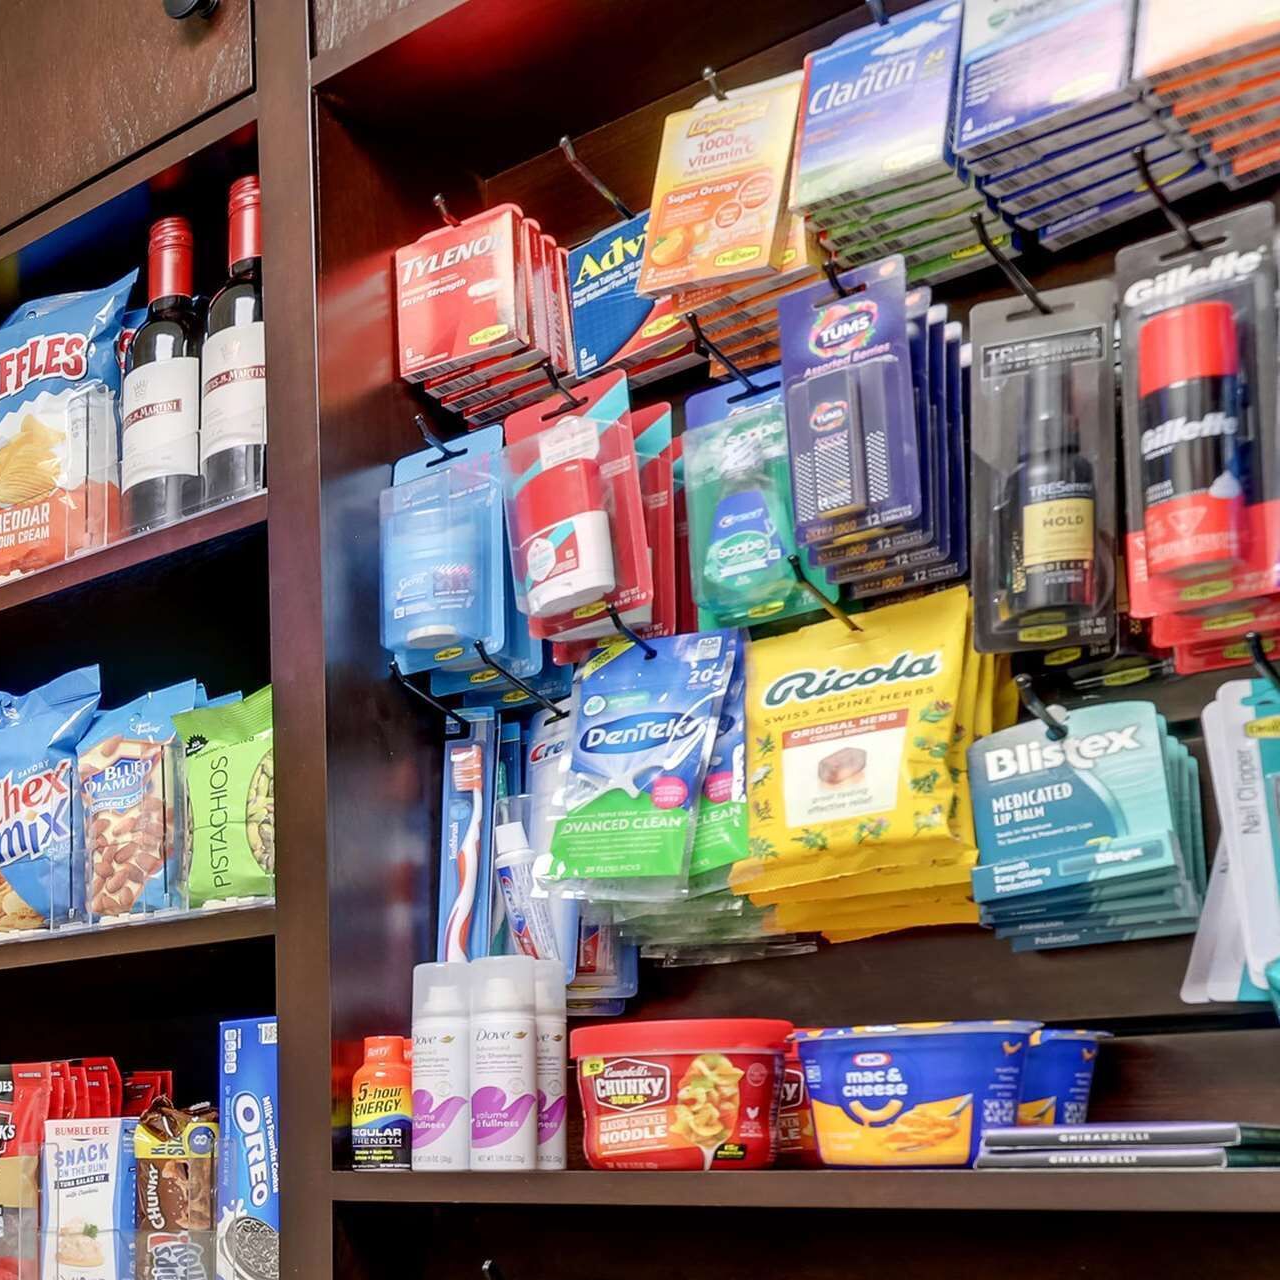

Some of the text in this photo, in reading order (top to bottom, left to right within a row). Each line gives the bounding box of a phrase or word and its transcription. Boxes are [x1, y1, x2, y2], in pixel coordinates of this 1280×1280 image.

[809, 57, 916, 117] Claritin
[667, 180, 740, 205] Super Orange
[1124, 245, 1269, 307] Gillette
[820, 315, 871, 342] TUMS
[140, 400, 179, 416] MARTINI
[1142, 411, 1240, 456] Gillette
[1041, 514, 1085, 529] HOLD
[18, 526, 50, 545] CREAM
[700, 637, 721, 647] ADA
[763, 653, 939, 707] Ricola
[764, 686, 934, 726] SWISS ALPINE HERBS
[791, 712, 898, 739] ORIGINAL HERB
[984, 722, 1143, 783] Blistex
[991, 782, 1073, 813] MEDICATED
[1237, 749, 1262, 836] Nail Clipper
[210, 755, 232, 888] PISTACHIOS
[993, 806, 1045, 827] LIP BALM
[475, 1029, 512, 1042] Dove
[595, 1076, 664, 1099] CHUNKY
[846, 1067, 902, 1084] mac &
[358, 1082, 403, 1103] 5-hour
[55, 1126, 109, 1136] BUMBLE BEE
[599, 1125, 668, 1145] NOODLE
[54, 1143, 109, 1168] SNACK
[234, 1090, 269, 1208] OREO
[147, 1163, 166, 1229] CHUNKY
